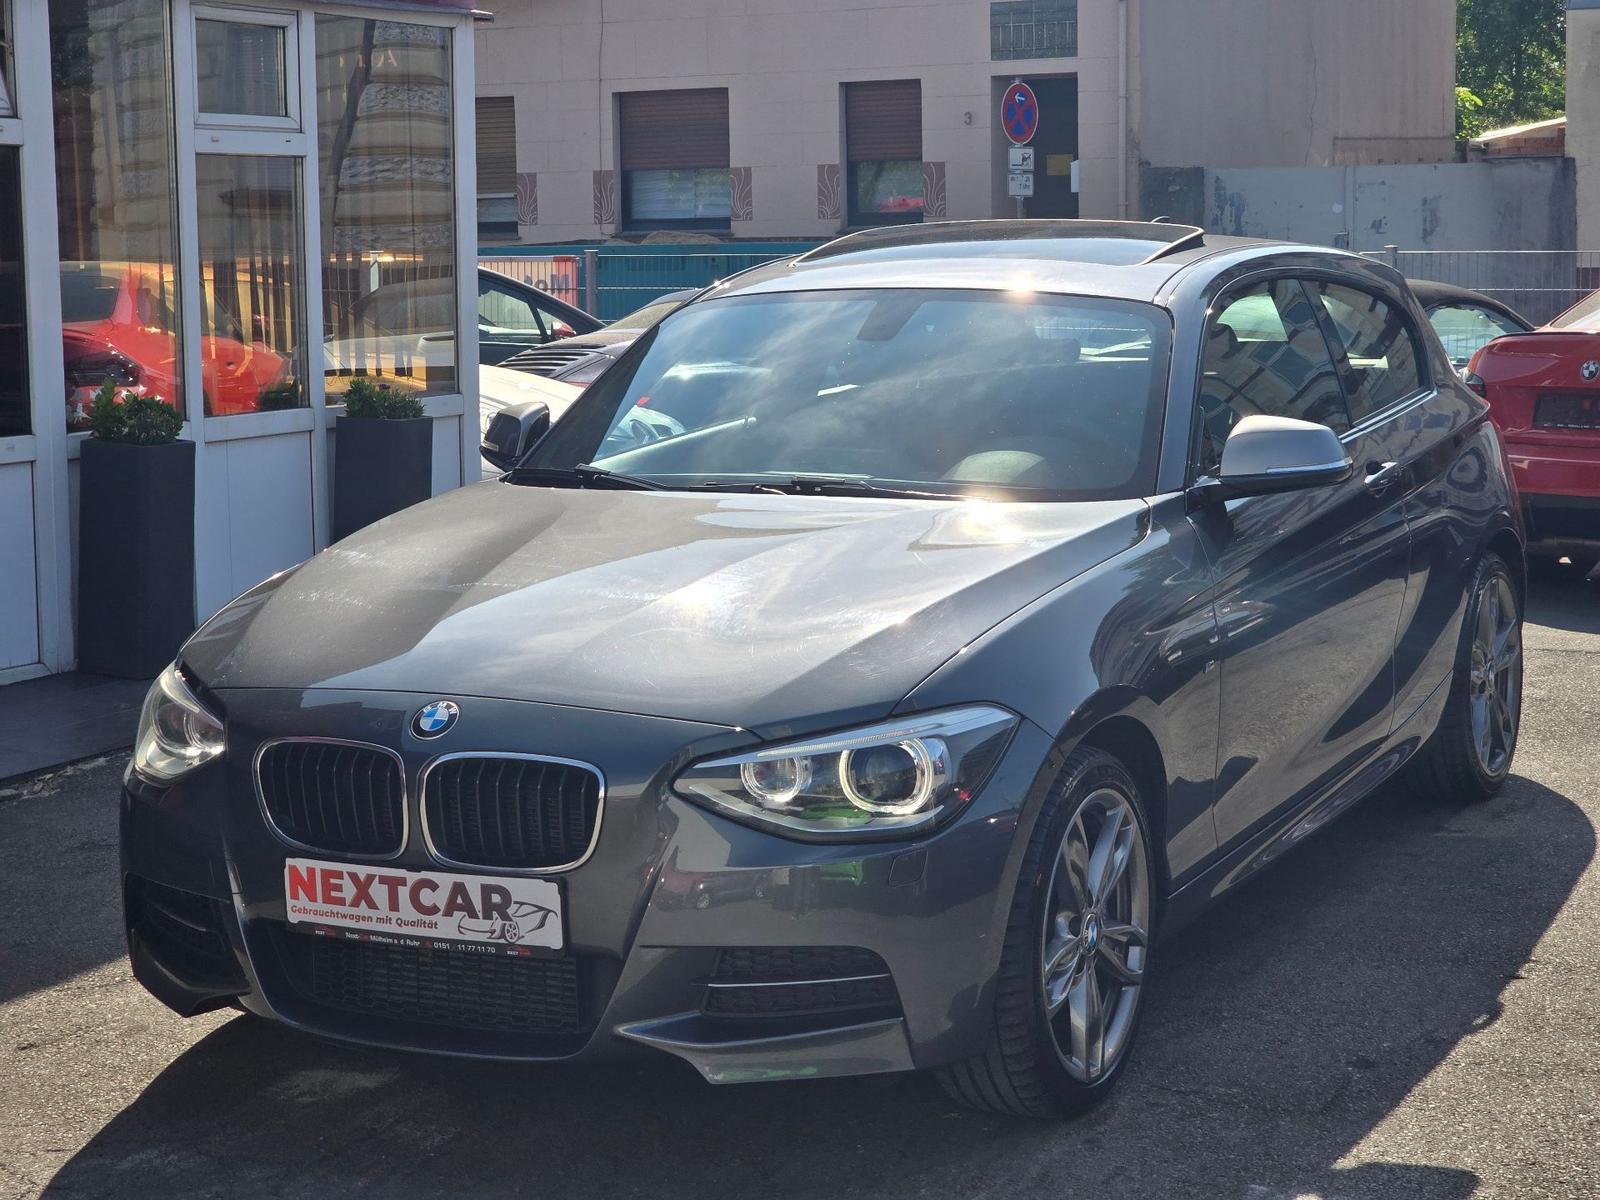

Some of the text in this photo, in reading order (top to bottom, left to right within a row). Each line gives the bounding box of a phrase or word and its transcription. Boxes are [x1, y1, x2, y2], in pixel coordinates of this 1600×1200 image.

[964, 112, 972, 126] 3
[288, 864, 514, 922] NEXTCAR
[291, 904, 438, 930] Gebrauchtwagen mit Qualität
[433, 942, 450, 950] 0151
